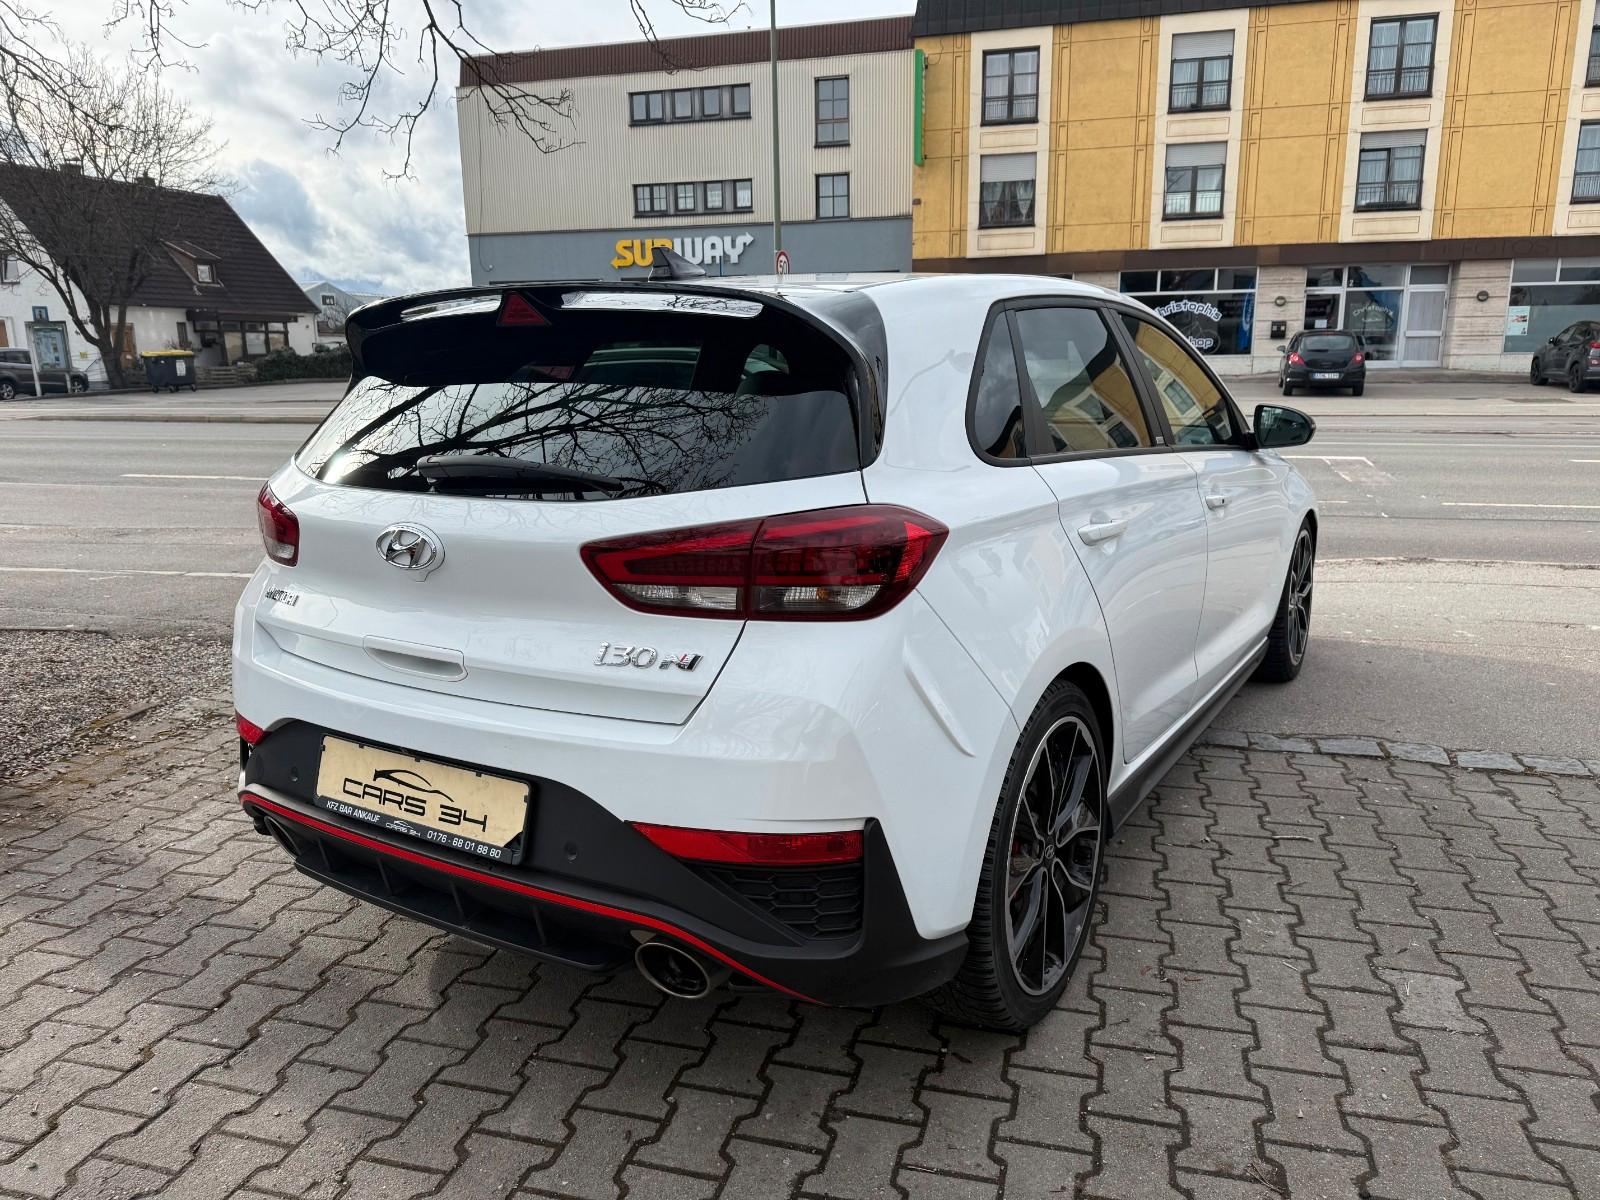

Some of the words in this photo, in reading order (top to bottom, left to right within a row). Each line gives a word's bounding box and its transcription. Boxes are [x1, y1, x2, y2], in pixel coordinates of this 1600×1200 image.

[611, 232, 754, 269] SUWAY
[1154, 300, 1222, 322] hristoph's
[1187, 336, 1214, 349] hop
[326, 800, 339, 811] KFZ
[339, 804, 353, 815] BAR
[353, 810, 381, 823] ANKAUF
[342, 777, 427, 817] CARS
[438, 803, 488, 832] 34
[427, 830, 447, 843] 0176
[464, 841, 475, 851] 01
